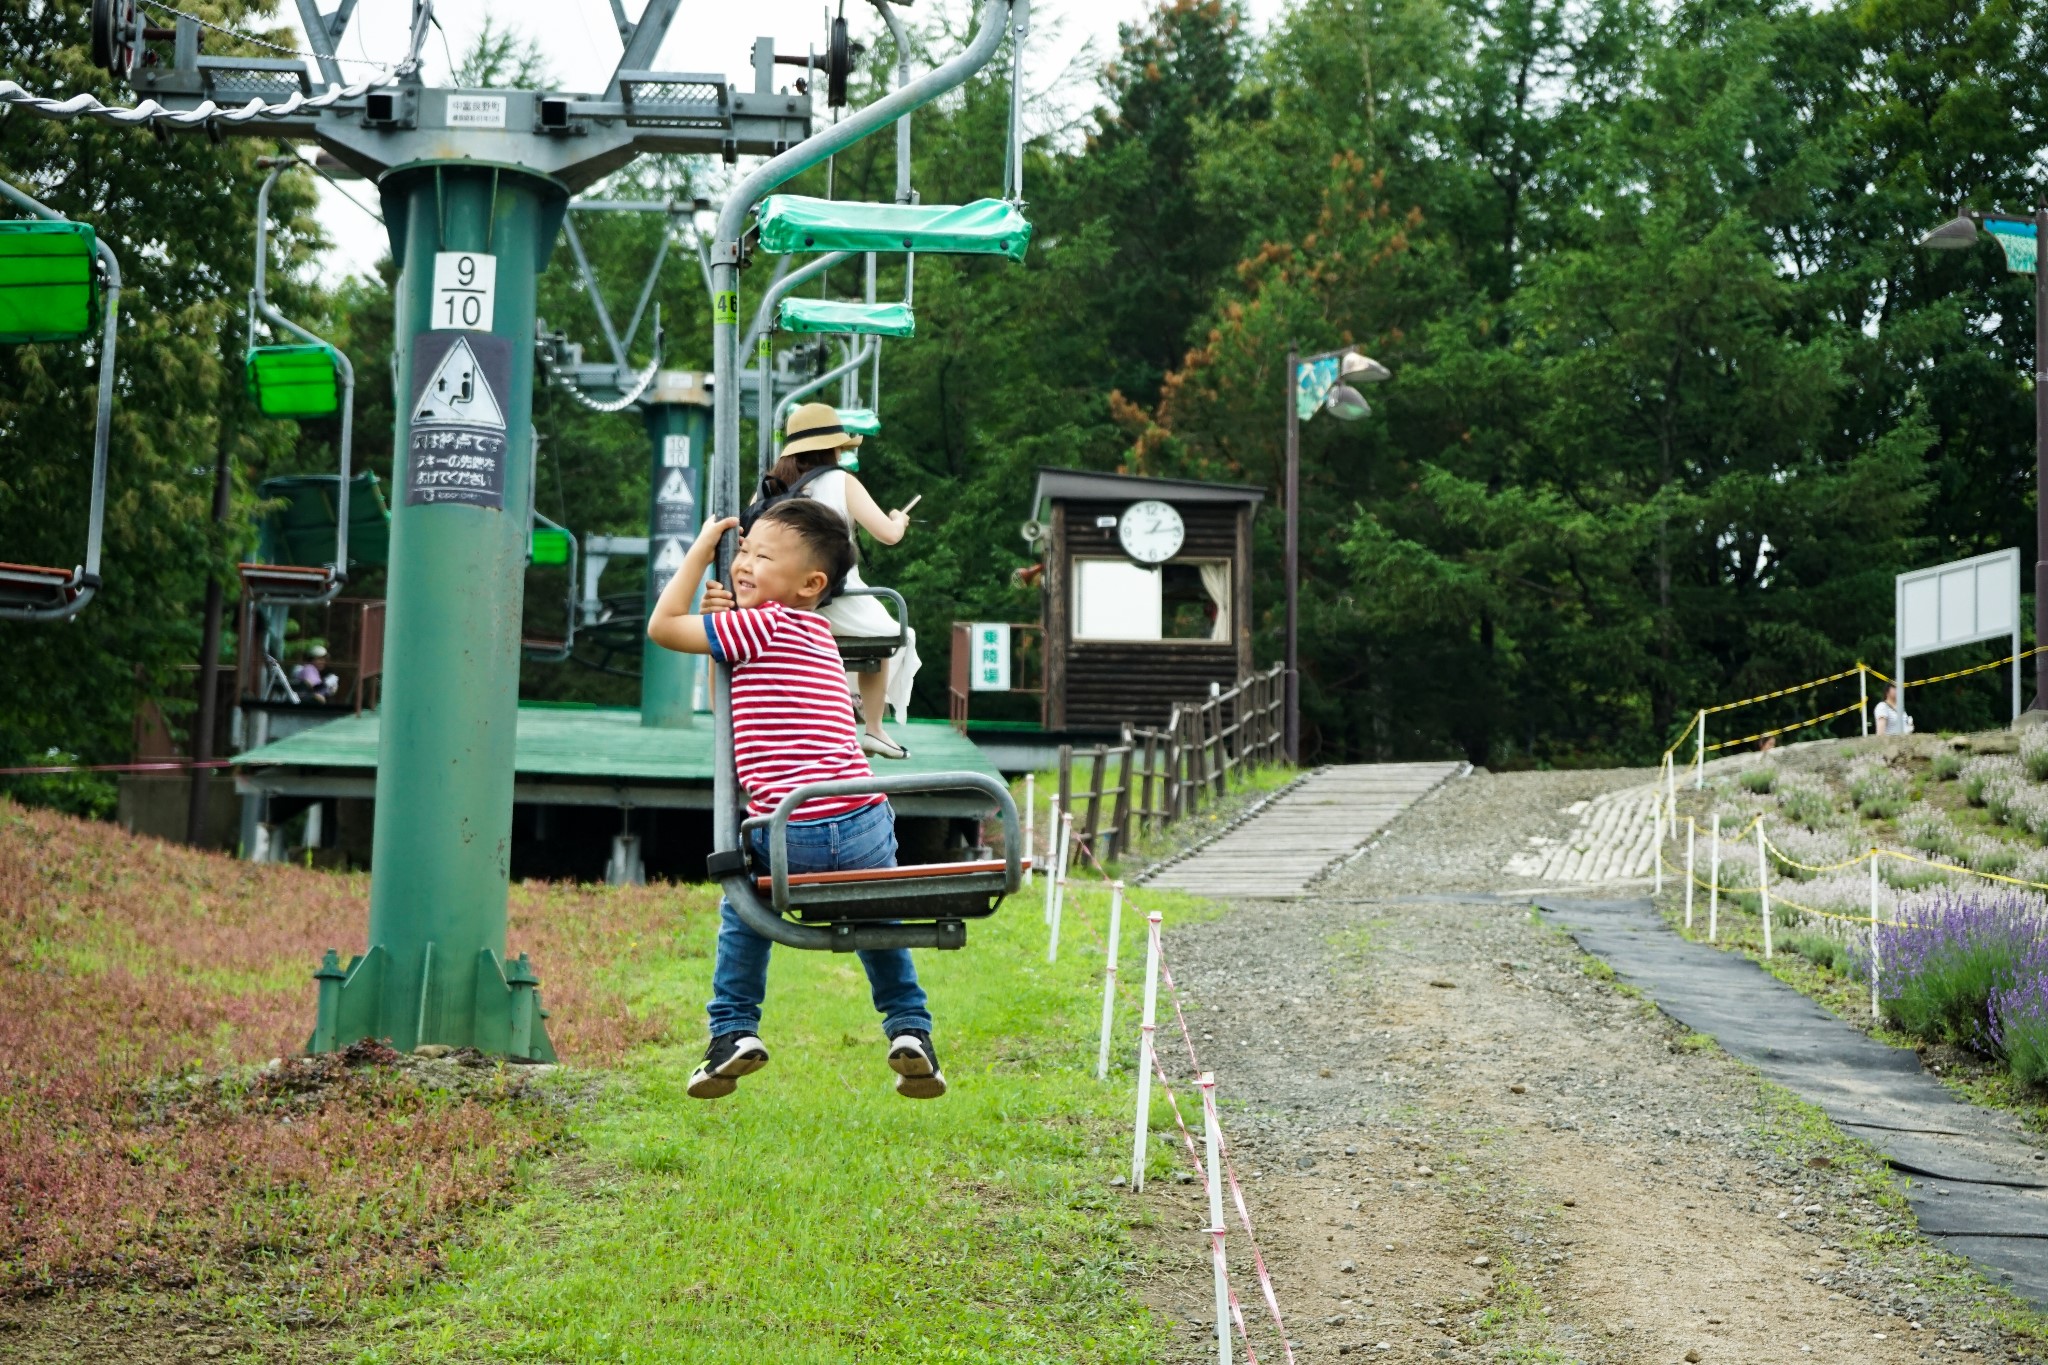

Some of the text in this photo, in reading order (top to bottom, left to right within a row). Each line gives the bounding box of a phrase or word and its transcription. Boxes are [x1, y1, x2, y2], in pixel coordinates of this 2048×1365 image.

[452, 100, 500, 111] 中富良野町
[458, 256, 475, 286] 9
[445, 295, 481, 326] 10
[717, 294, 737, 313] 46
